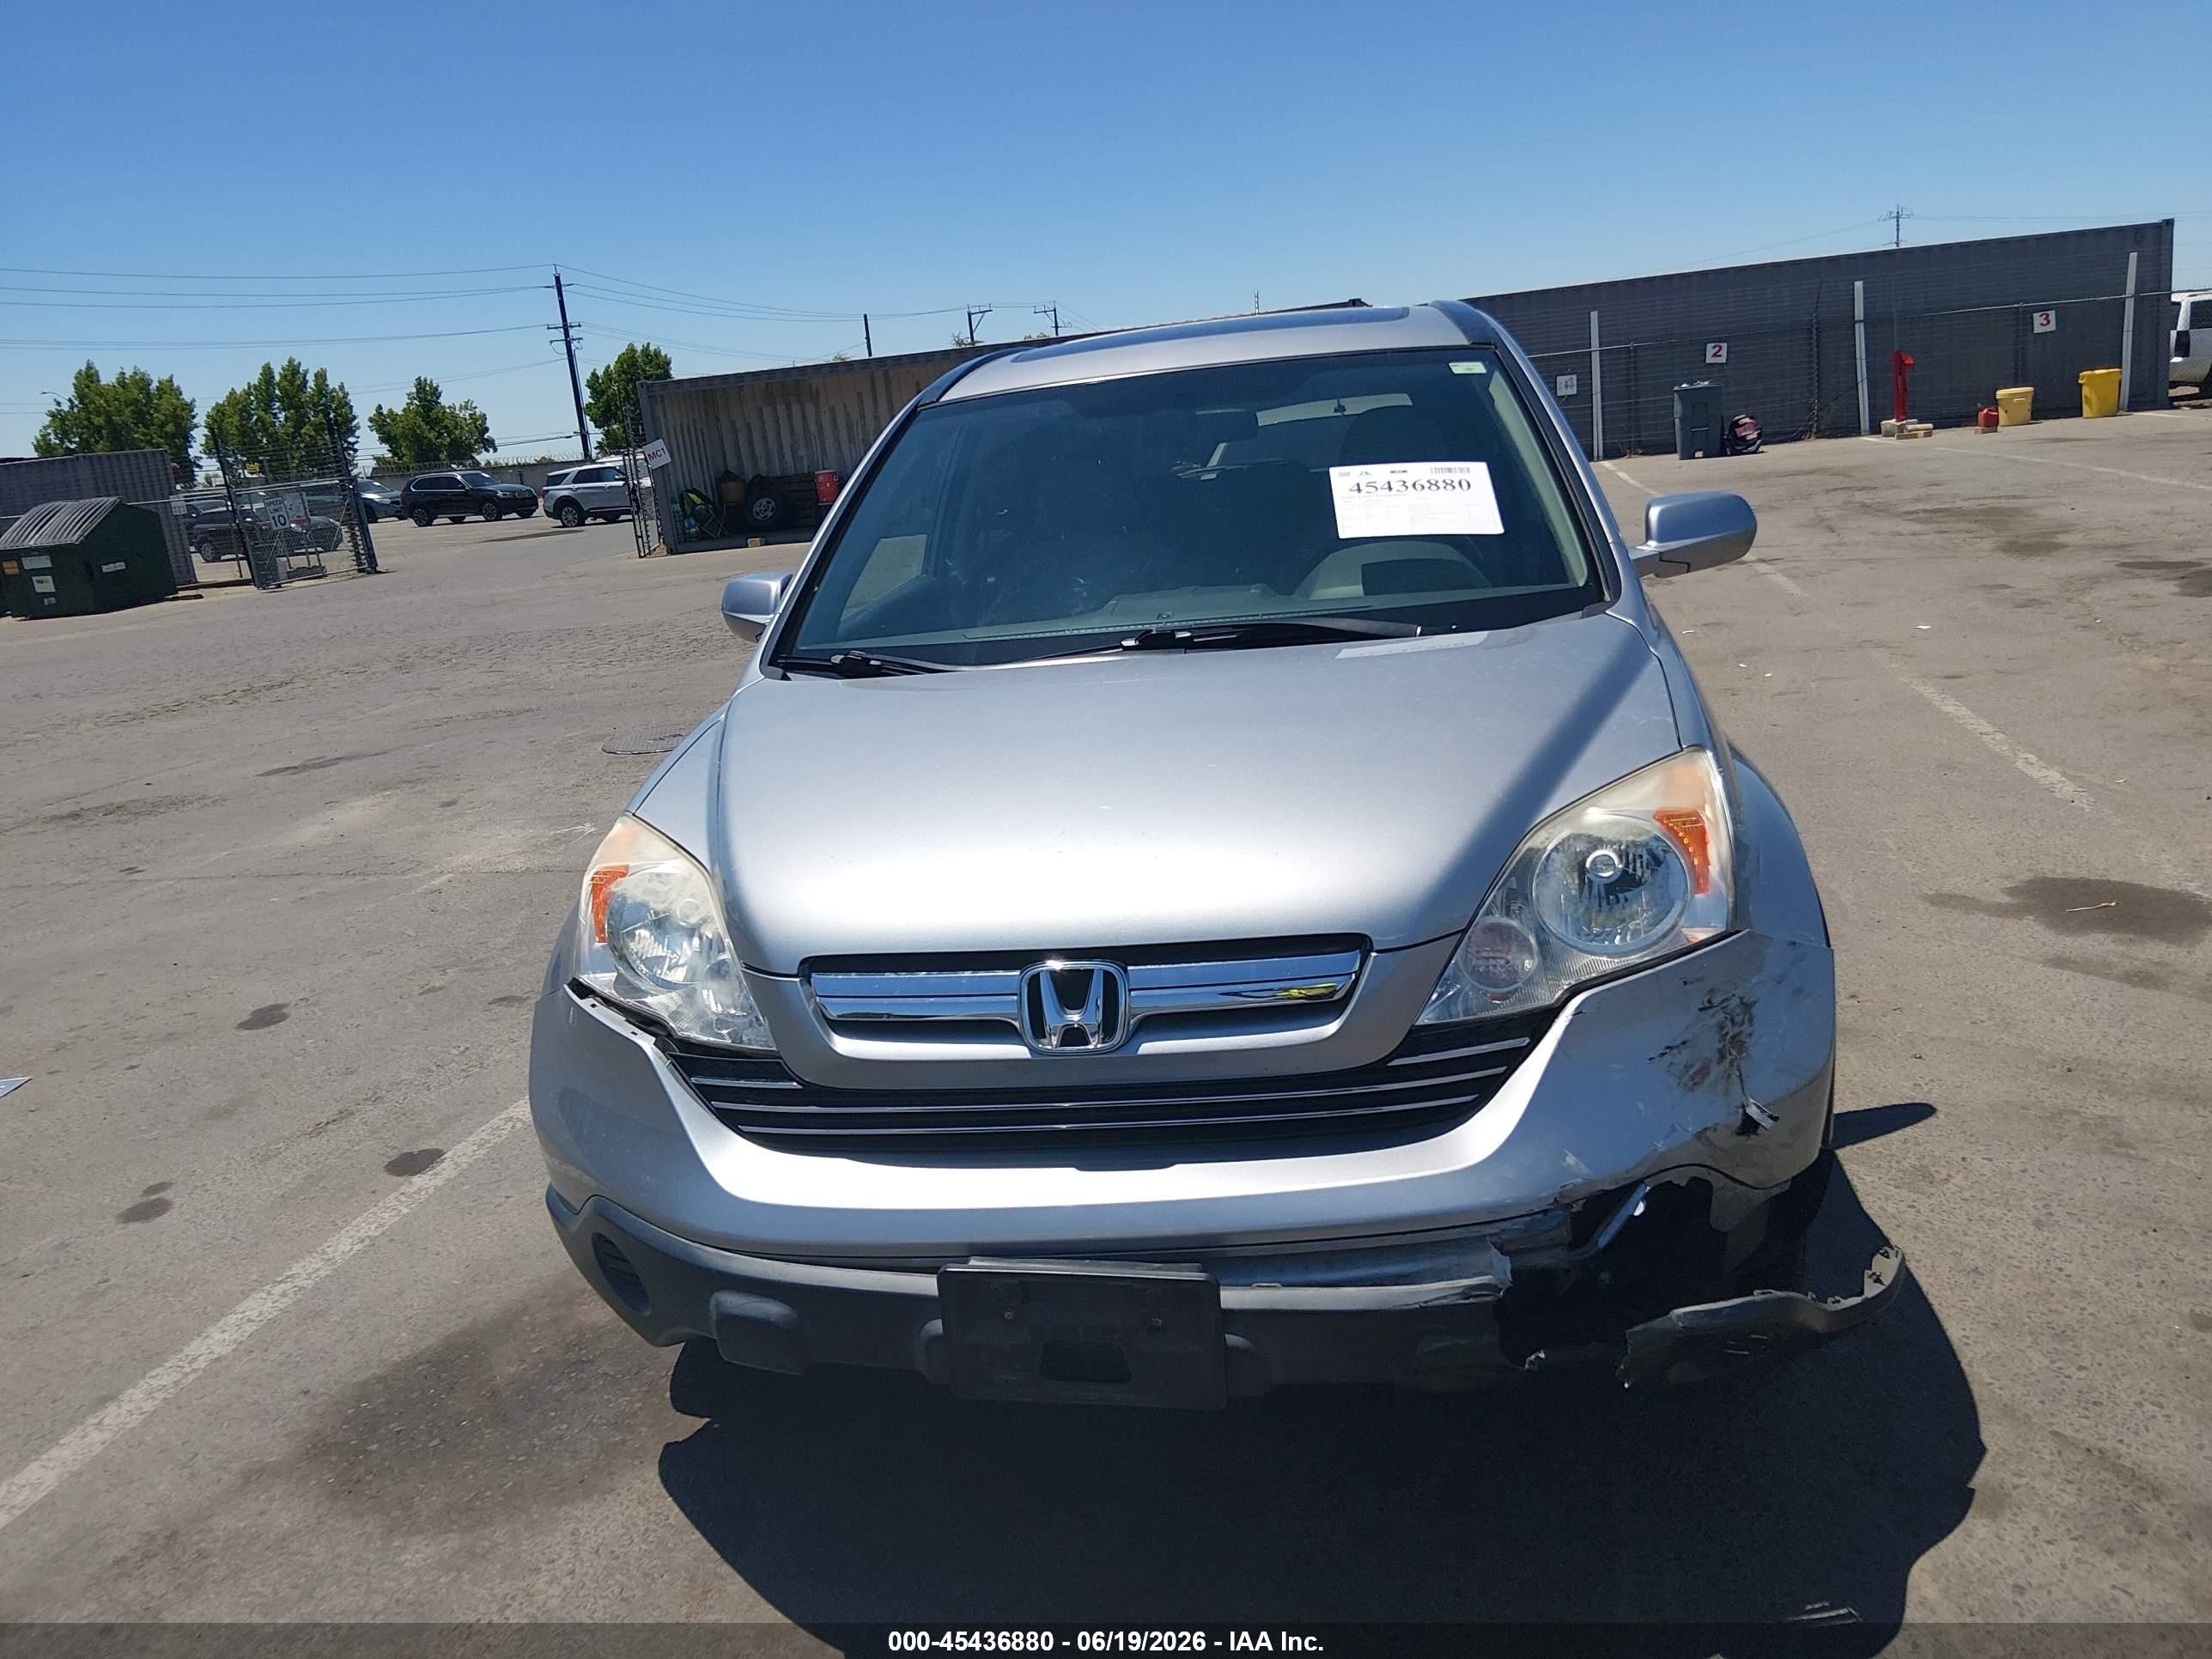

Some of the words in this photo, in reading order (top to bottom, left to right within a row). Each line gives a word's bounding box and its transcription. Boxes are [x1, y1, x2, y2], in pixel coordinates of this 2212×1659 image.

[2039, 313, 2051, 326] 3
[1711, 344, 1723, 358] 2
[647, 447, 666, 461] MC1
[1348, 477, 1472, 495] 45436880
[271, 514, 287, 528] 10
